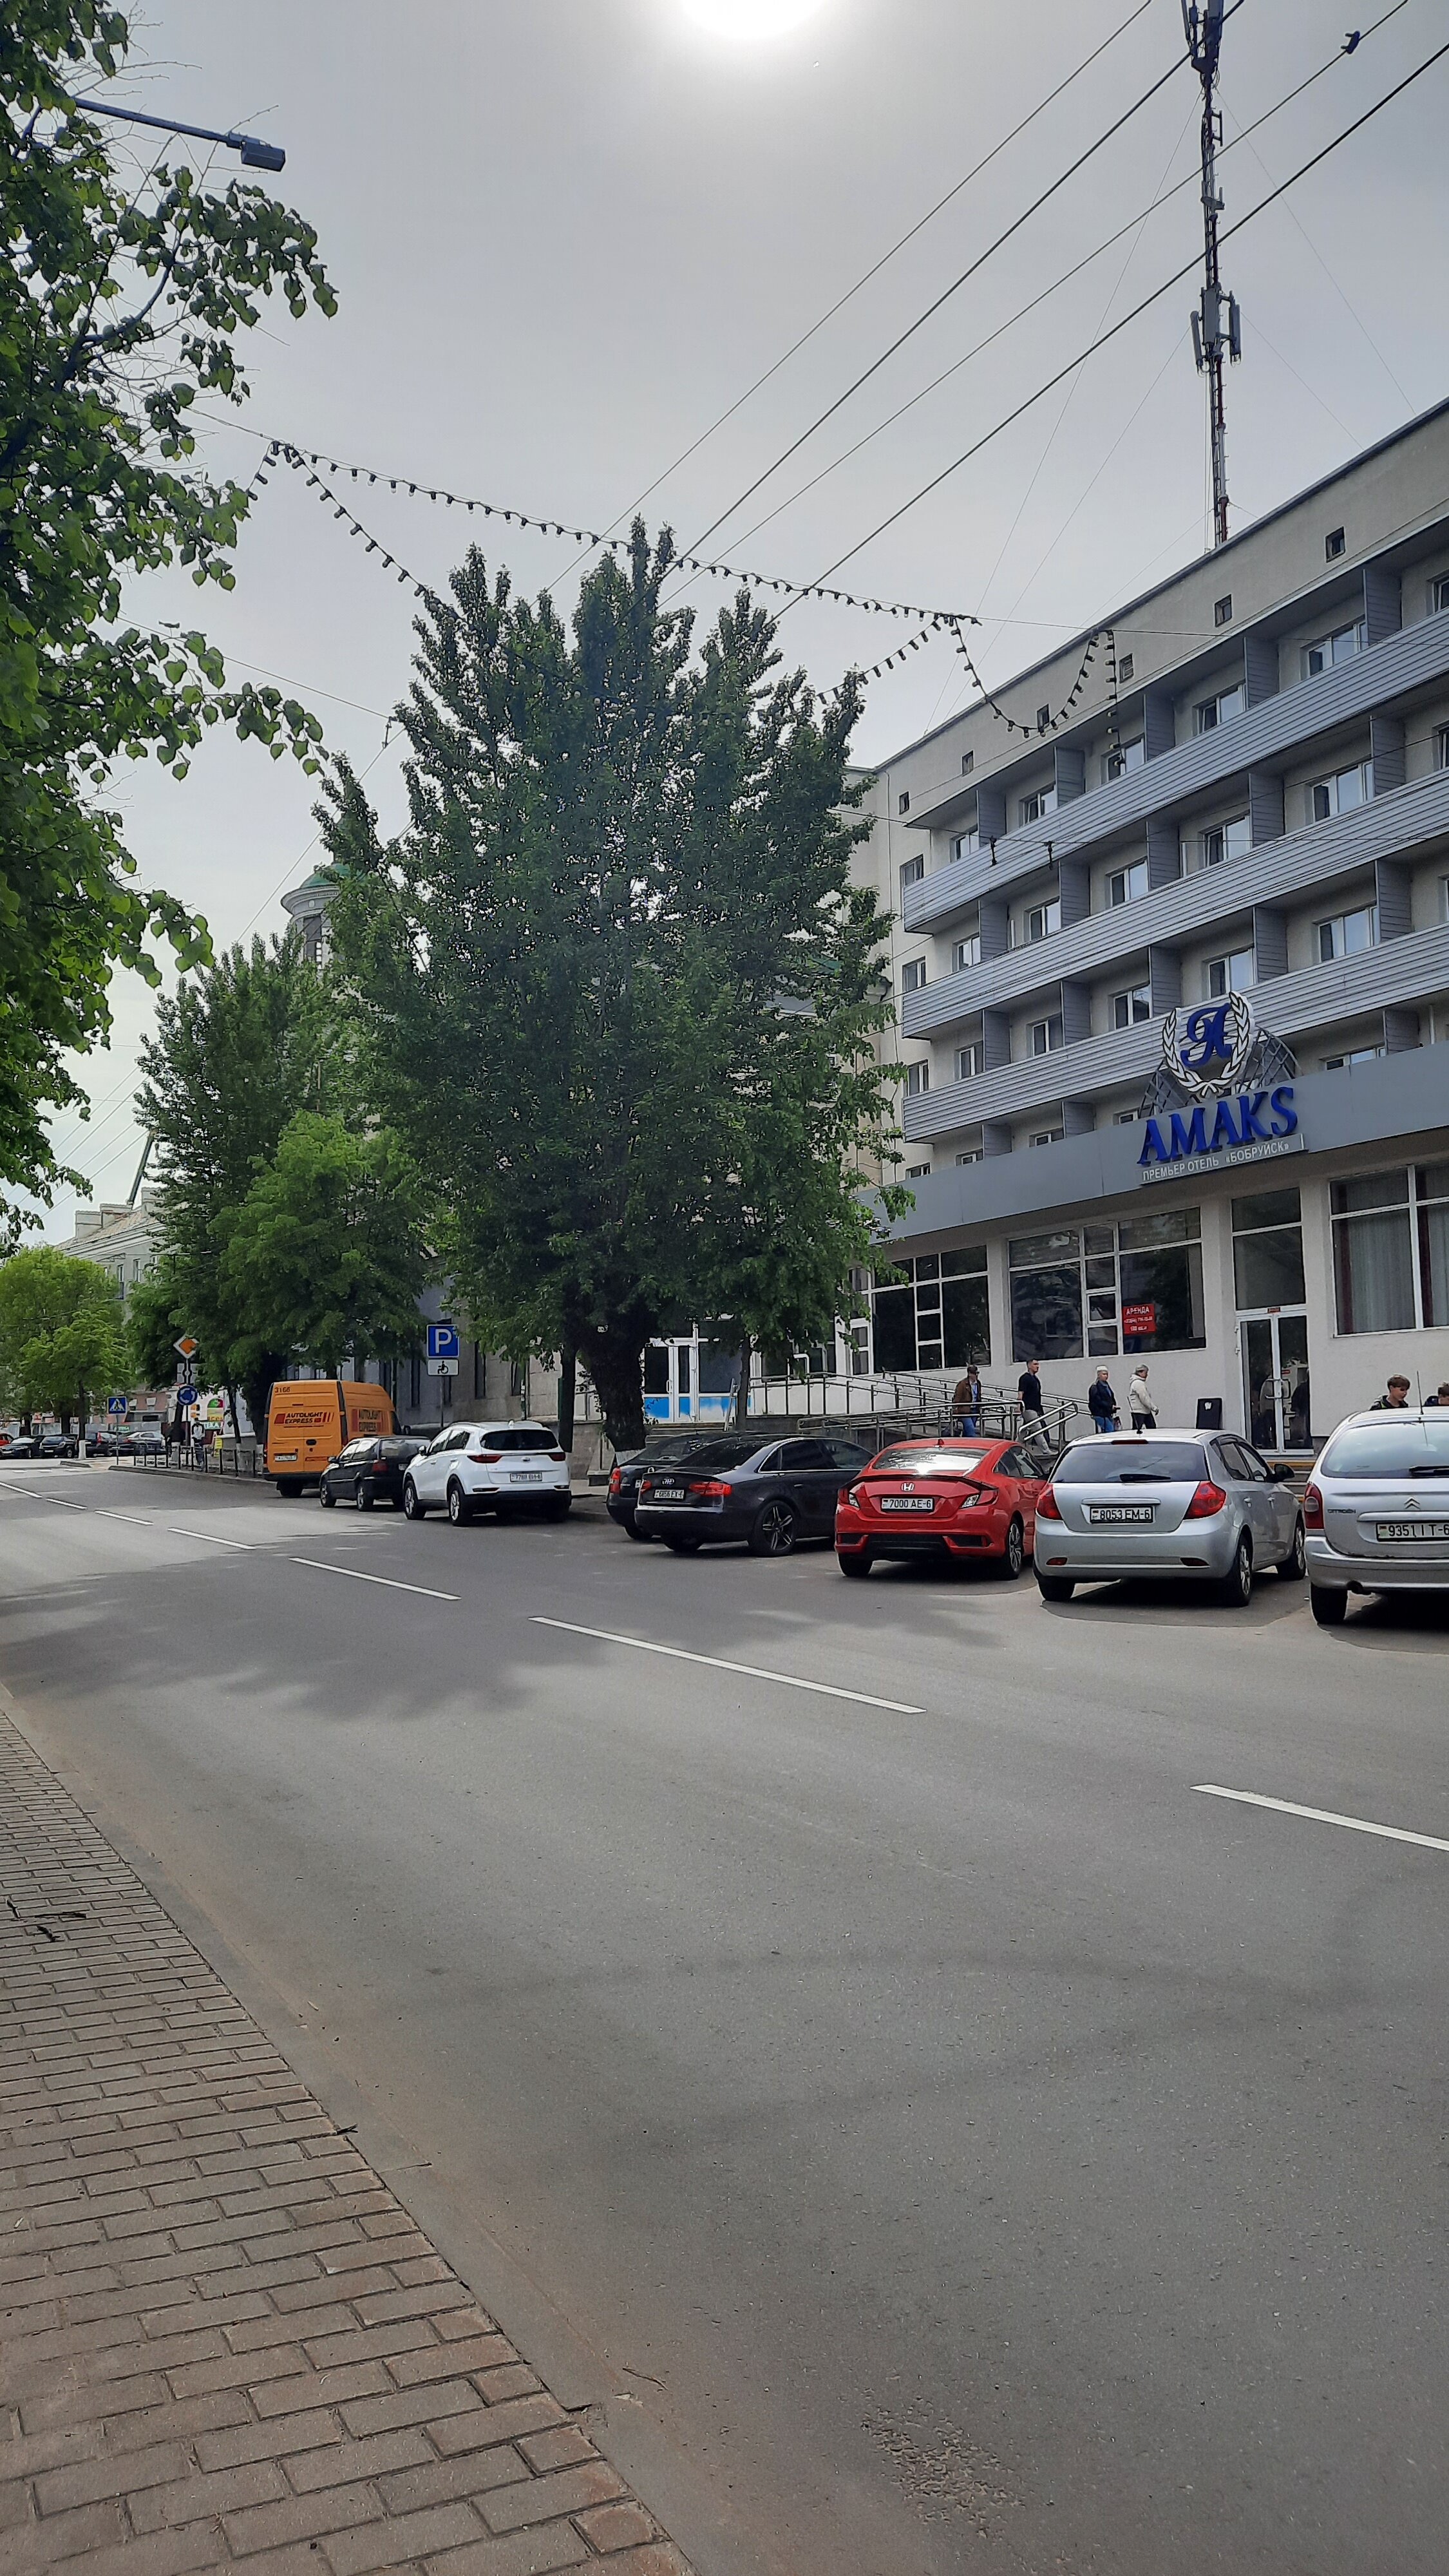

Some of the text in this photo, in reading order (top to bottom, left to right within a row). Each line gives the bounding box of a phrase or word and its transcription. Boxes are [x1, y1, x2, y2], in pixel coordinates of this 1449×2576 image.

[1137, 1087, 1298, 1166] AMAKS
[1143, 1141, 1289, 1181] ПРЕМЬЕР ОТЕЛЬ «БОБРУЙСК»
[1126, 1306, 1150, 1315] АРЕНДА
[435, 1329, 451, 1353] P
[889, 1499, 931, 1508] 7000 AE-6
[1100, 1509, 1150, 1520] 8053 EM-6
[1388, 1524, 1417, 1537] 9351
